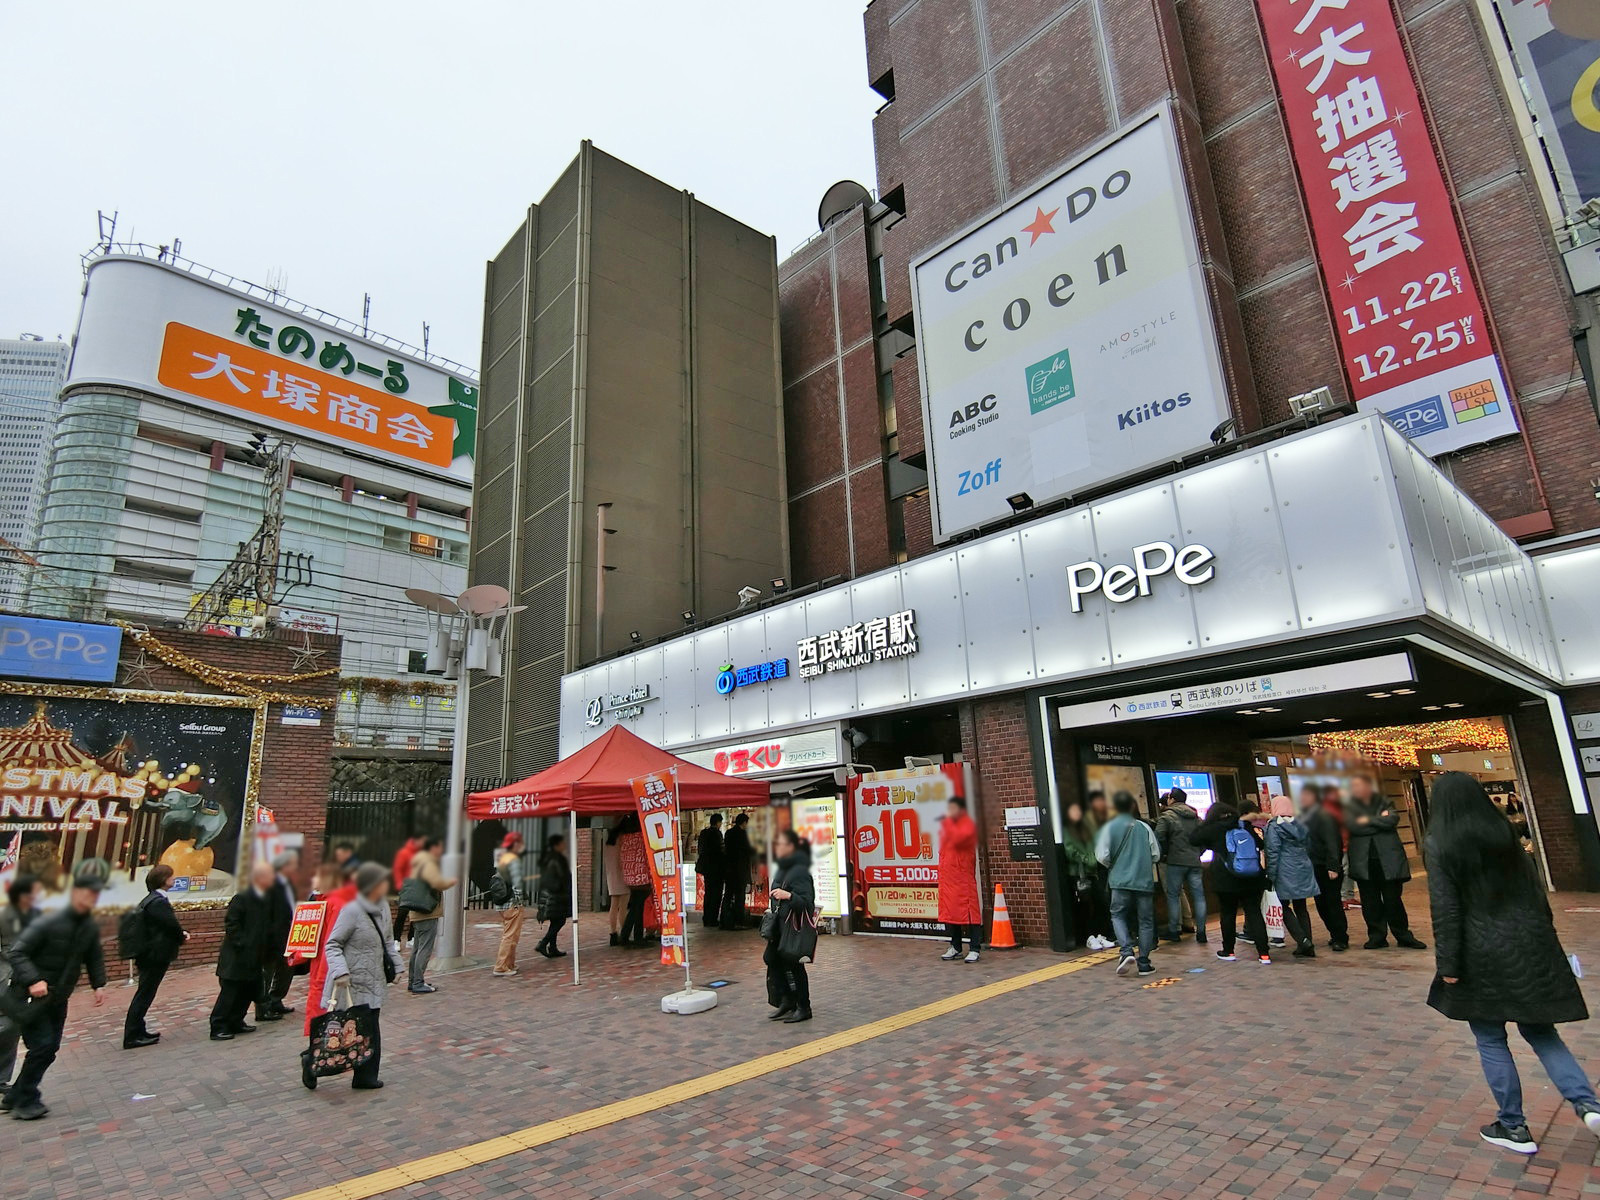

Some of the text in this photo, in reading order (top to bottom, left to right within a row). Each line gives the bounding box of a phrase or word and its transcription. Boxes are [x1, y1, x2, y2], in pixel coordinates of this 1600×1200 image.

[1448, 266, 1463, 295] FRI
[964, 243, 1128, 353] coen
[1342, 271, 1452, 335] 11.22
[1458, 315, 1476, 345] WED
[234, 307, 410, 394] たのめーる
[1353, 321, 1461, 383] 12.25
[190, 352, 434, 449] 大塚商会
[1033, 389, 1058, 405] hands
[1059, 384, 1070, 393] be
[1454, 383, 1493, 401] Brick
[949, 394, 998, 429] ABC
[949, 412, 999, 440] Cooking Studio
[1118, 391, 1192, 431] Kiitos
[957, 457, 1002, 497] Zoff
[1065, 540, 1216, 614] PePe
[0, 627, 108, 664] PePe
[796, 608, 919, 668] 西武新宿駅
[735, 658, 790, 688] 西武鉄道
[799, 641, 919, 679] SEIBU SHINJUKU STATION
[1138, 680, 1257, 711] 西武鉄道 西武線のりば
[202, 724, 226, 733] Group
[729, 744, 782, 774] 宝くじ
[489, 792, 540, 815] 大黒天宝くじ
[60, 822, 94, 831] PEPE
[873, 868, 891, 881] ミニ
[290, 923, 319, 943] 寅の日
